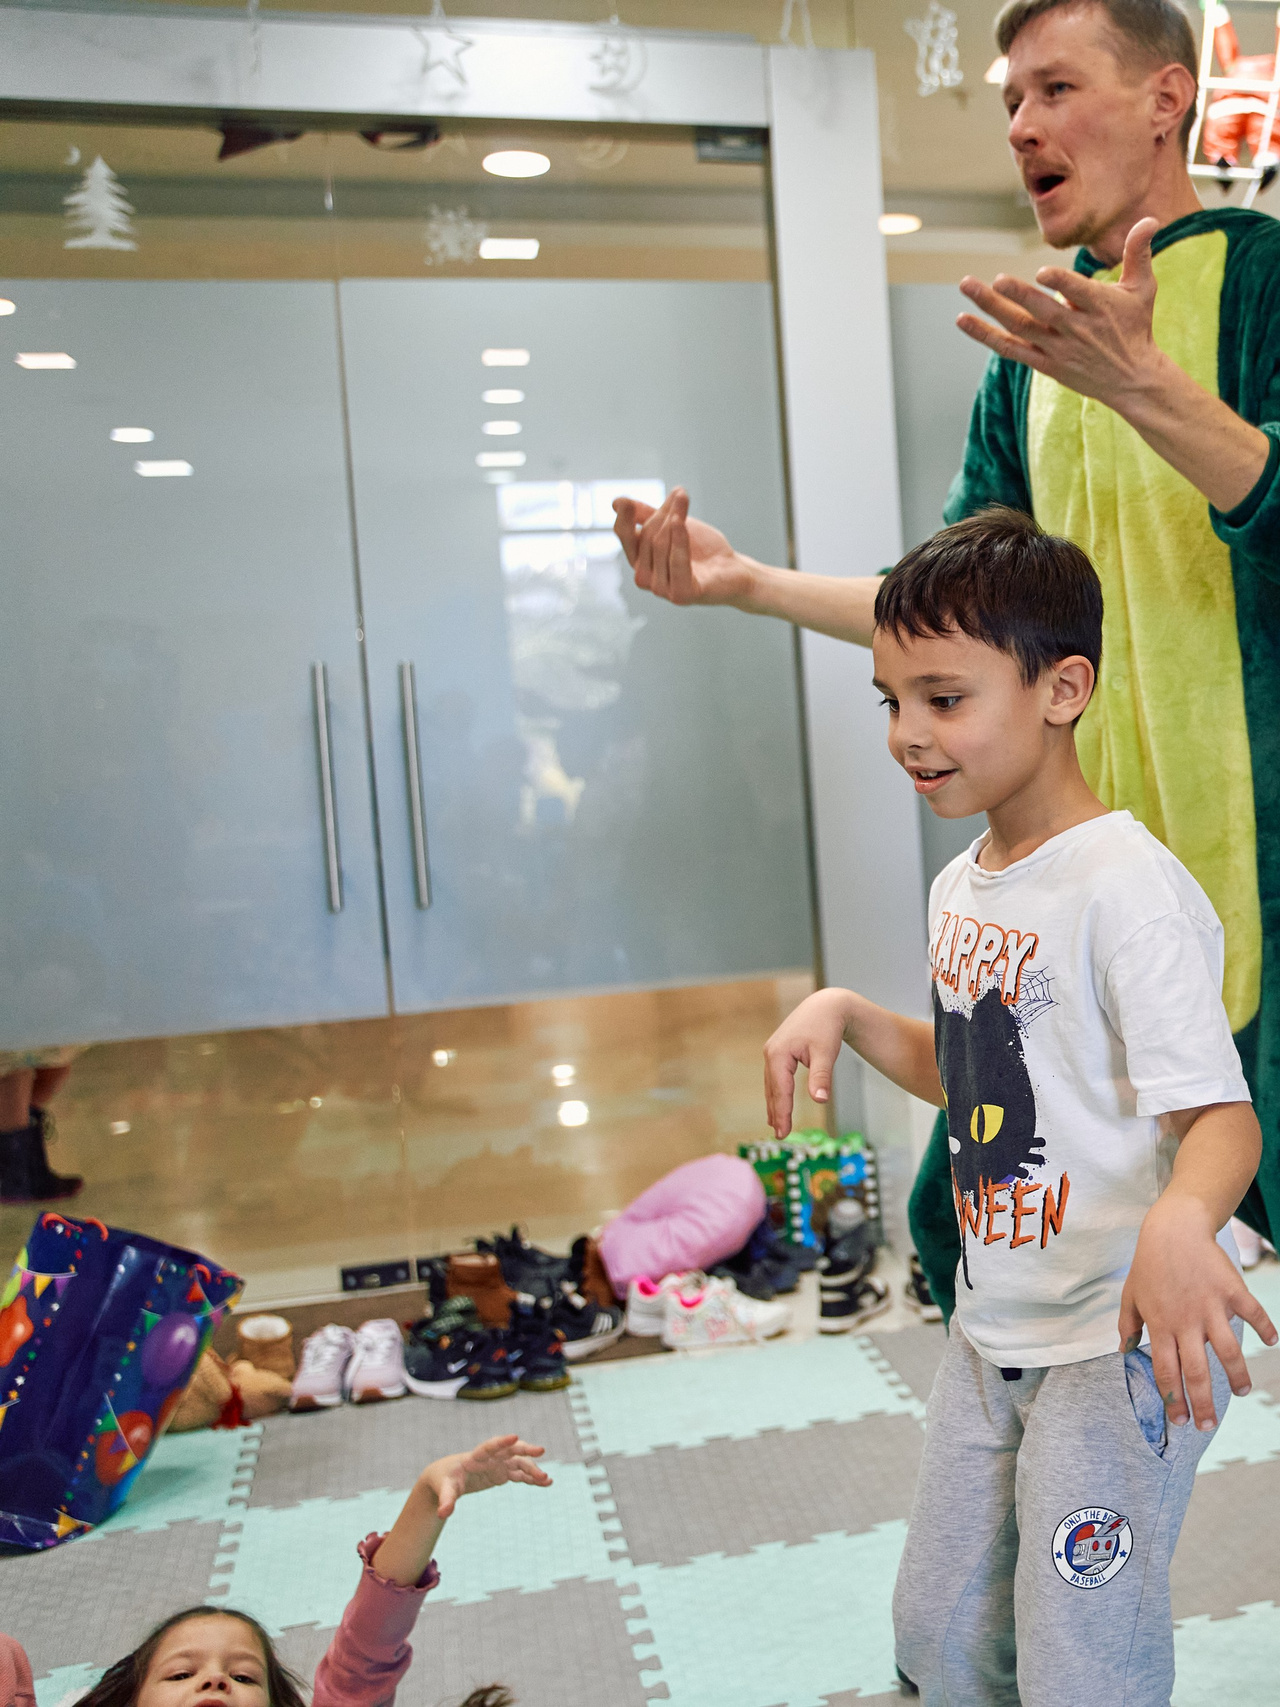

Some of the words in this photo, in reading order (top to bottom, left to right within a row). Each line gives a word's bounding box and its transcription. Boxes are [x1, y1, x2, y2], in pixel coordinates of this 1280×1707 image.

[929, 911, 1038, 1006] HAPPY
[1064, 1512, 1082, 1530] ONLY
[1084, 1510, 1101, 1520] THE
[1069, 1573, 1106, 1586] BASEBALL
